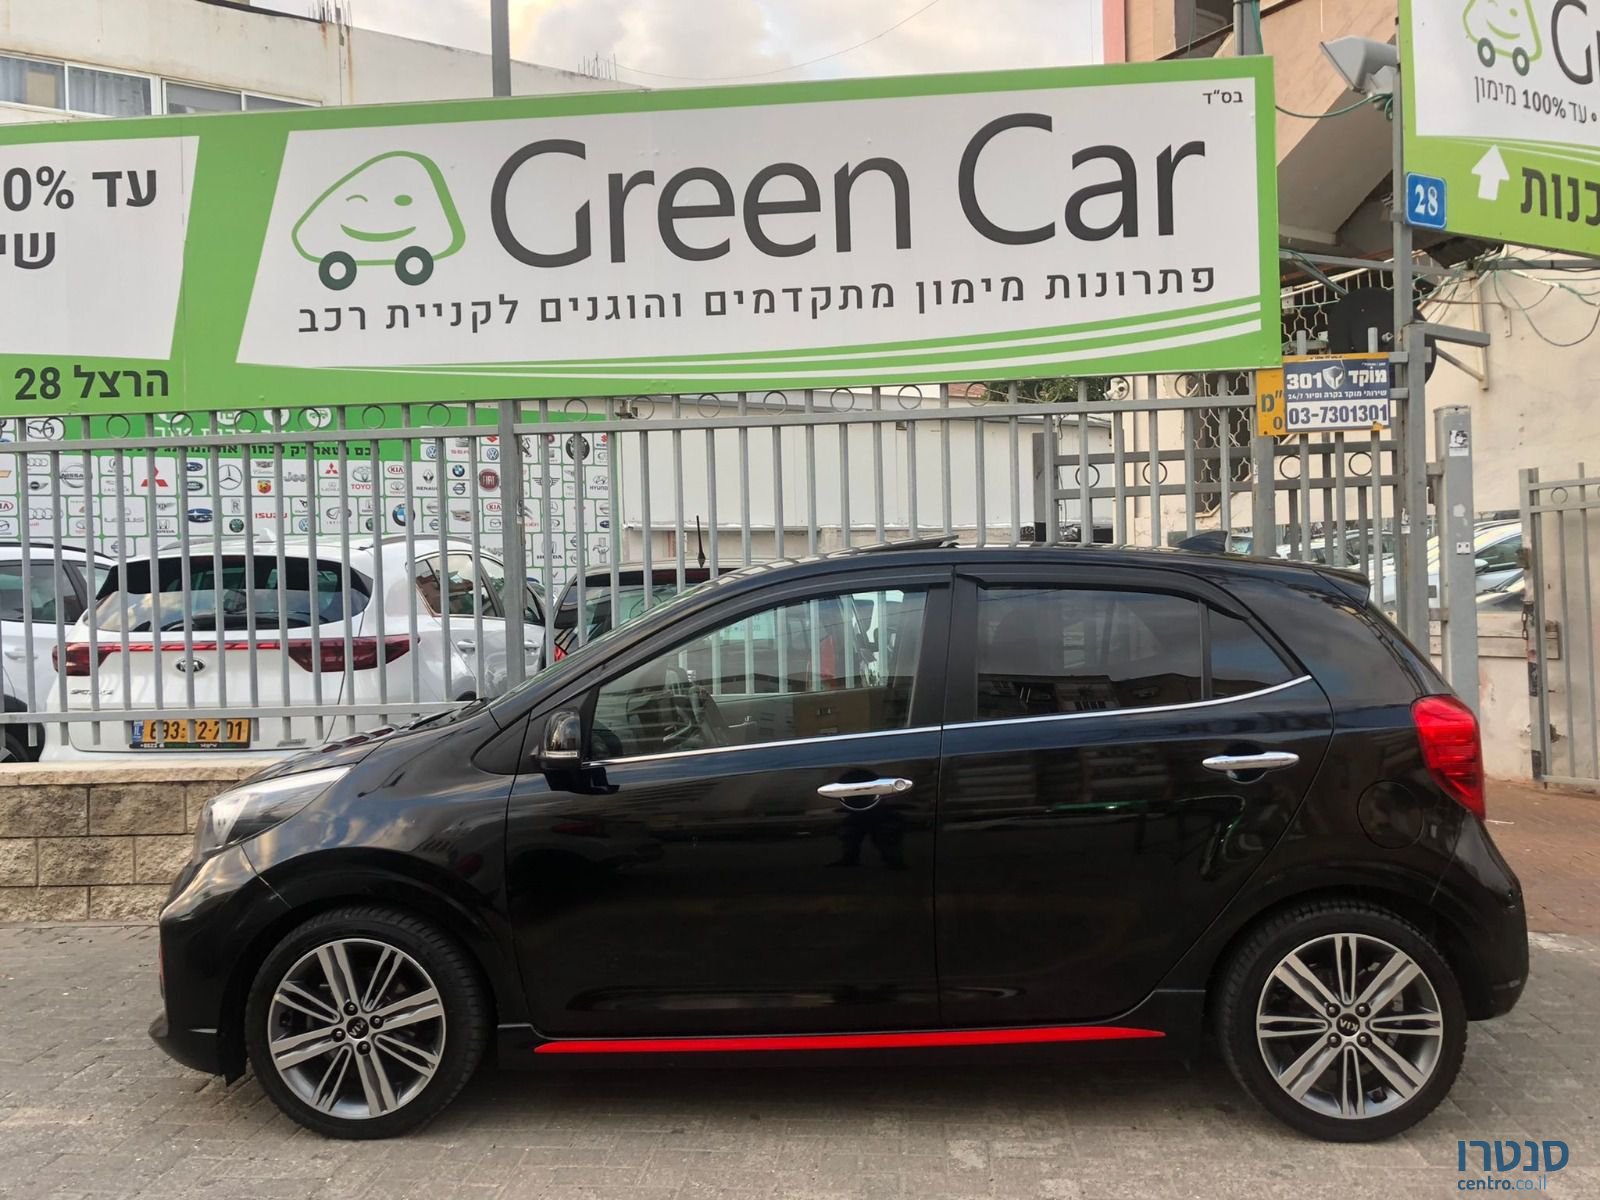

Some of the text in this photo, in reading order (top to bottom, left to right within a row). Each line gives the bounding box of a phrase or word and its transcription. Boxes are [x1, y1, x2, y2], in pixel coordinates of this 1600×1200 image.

[1202, 89, 1243, 104] בס"ד
[1474, 76, 1587, 124] עד 100% מימון
[92, 169, 157, 207] עד
[491, 112, 1206, 268] Green Car
[1414, 184, 1439, 216] 28
[298, 267, 1215, 333] פתרונות מימון מתקדמים והוגנים לקניית רכב
[14, 364, 169, 401] הרצל 28
[1286, 365, 1387, 390] מוקד 301
[1344, 390, 1361, 398] מוקד
[1288, 404, 1387, 425] 03-7301301
[348, 1019, 368, 1037] KIA
[1339, 1018, 1359, 1032] KIA
